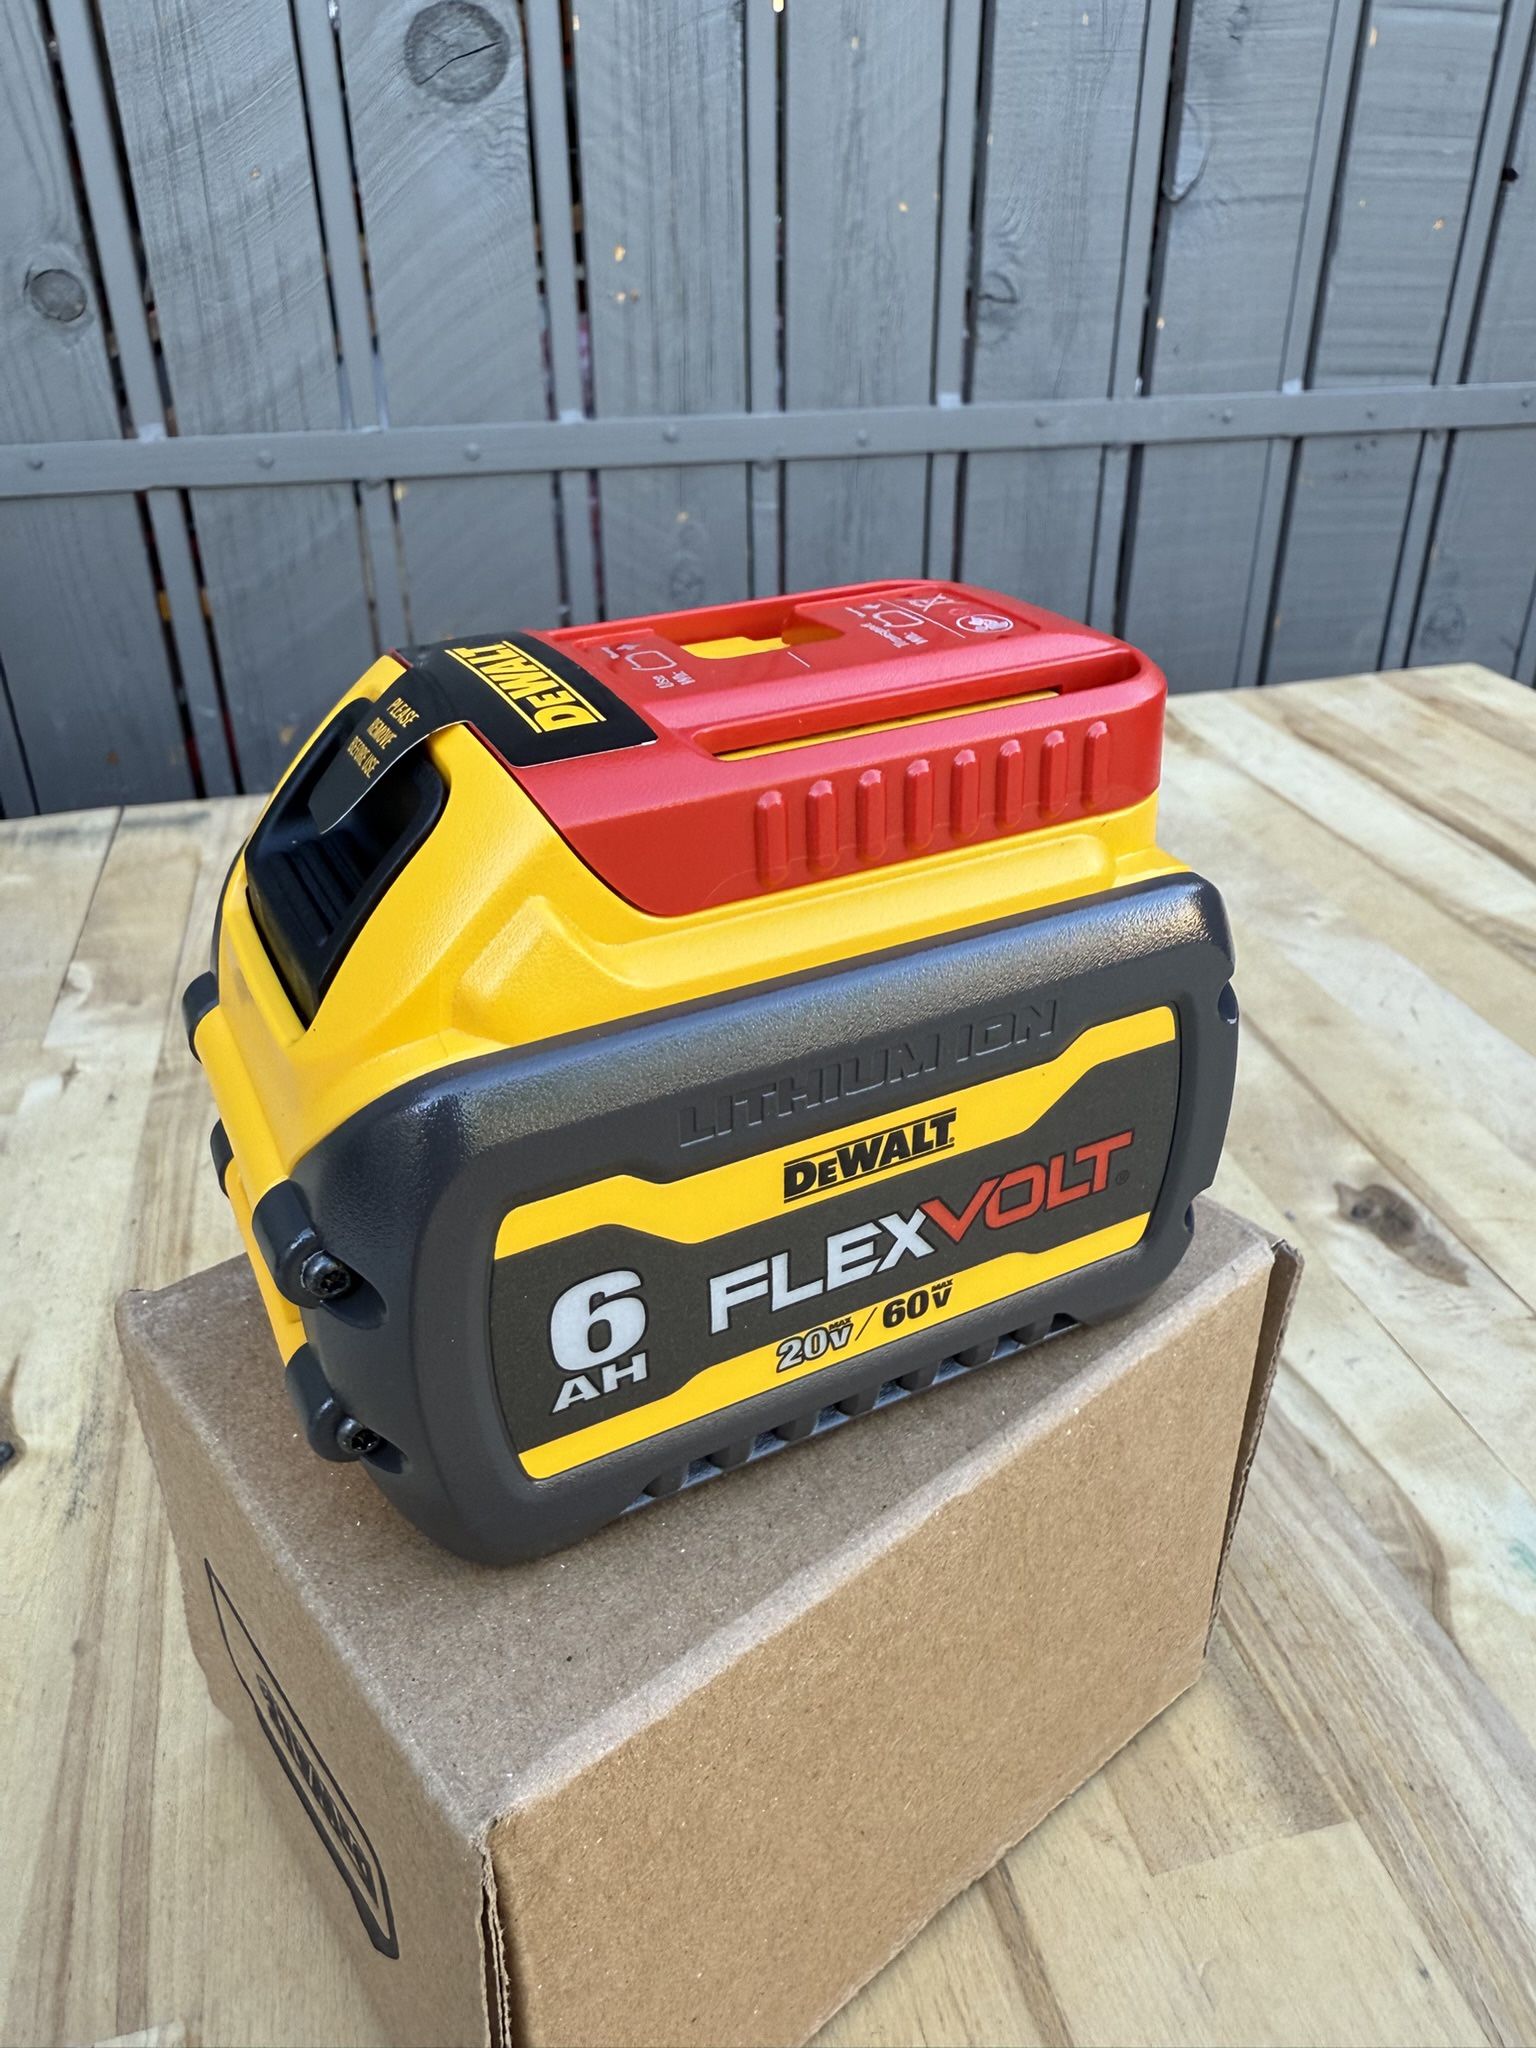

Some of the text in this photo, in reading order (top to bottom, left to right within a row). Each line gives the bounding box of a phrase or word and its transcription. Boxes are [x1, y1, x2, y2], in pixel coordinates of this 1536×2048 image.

[366, 717, 398, 750] REMOVE
[386, 697, 420, 728] PLEASE
[361, 753, 380, 778] USE
[679, 999, 1057, 1147] LITHIUM ION
[708, 1128, 1134, 1336] FLEXVOLT
[549, 1268, 648, 1372] 6
[551, 1352, 649, 1415] AH
